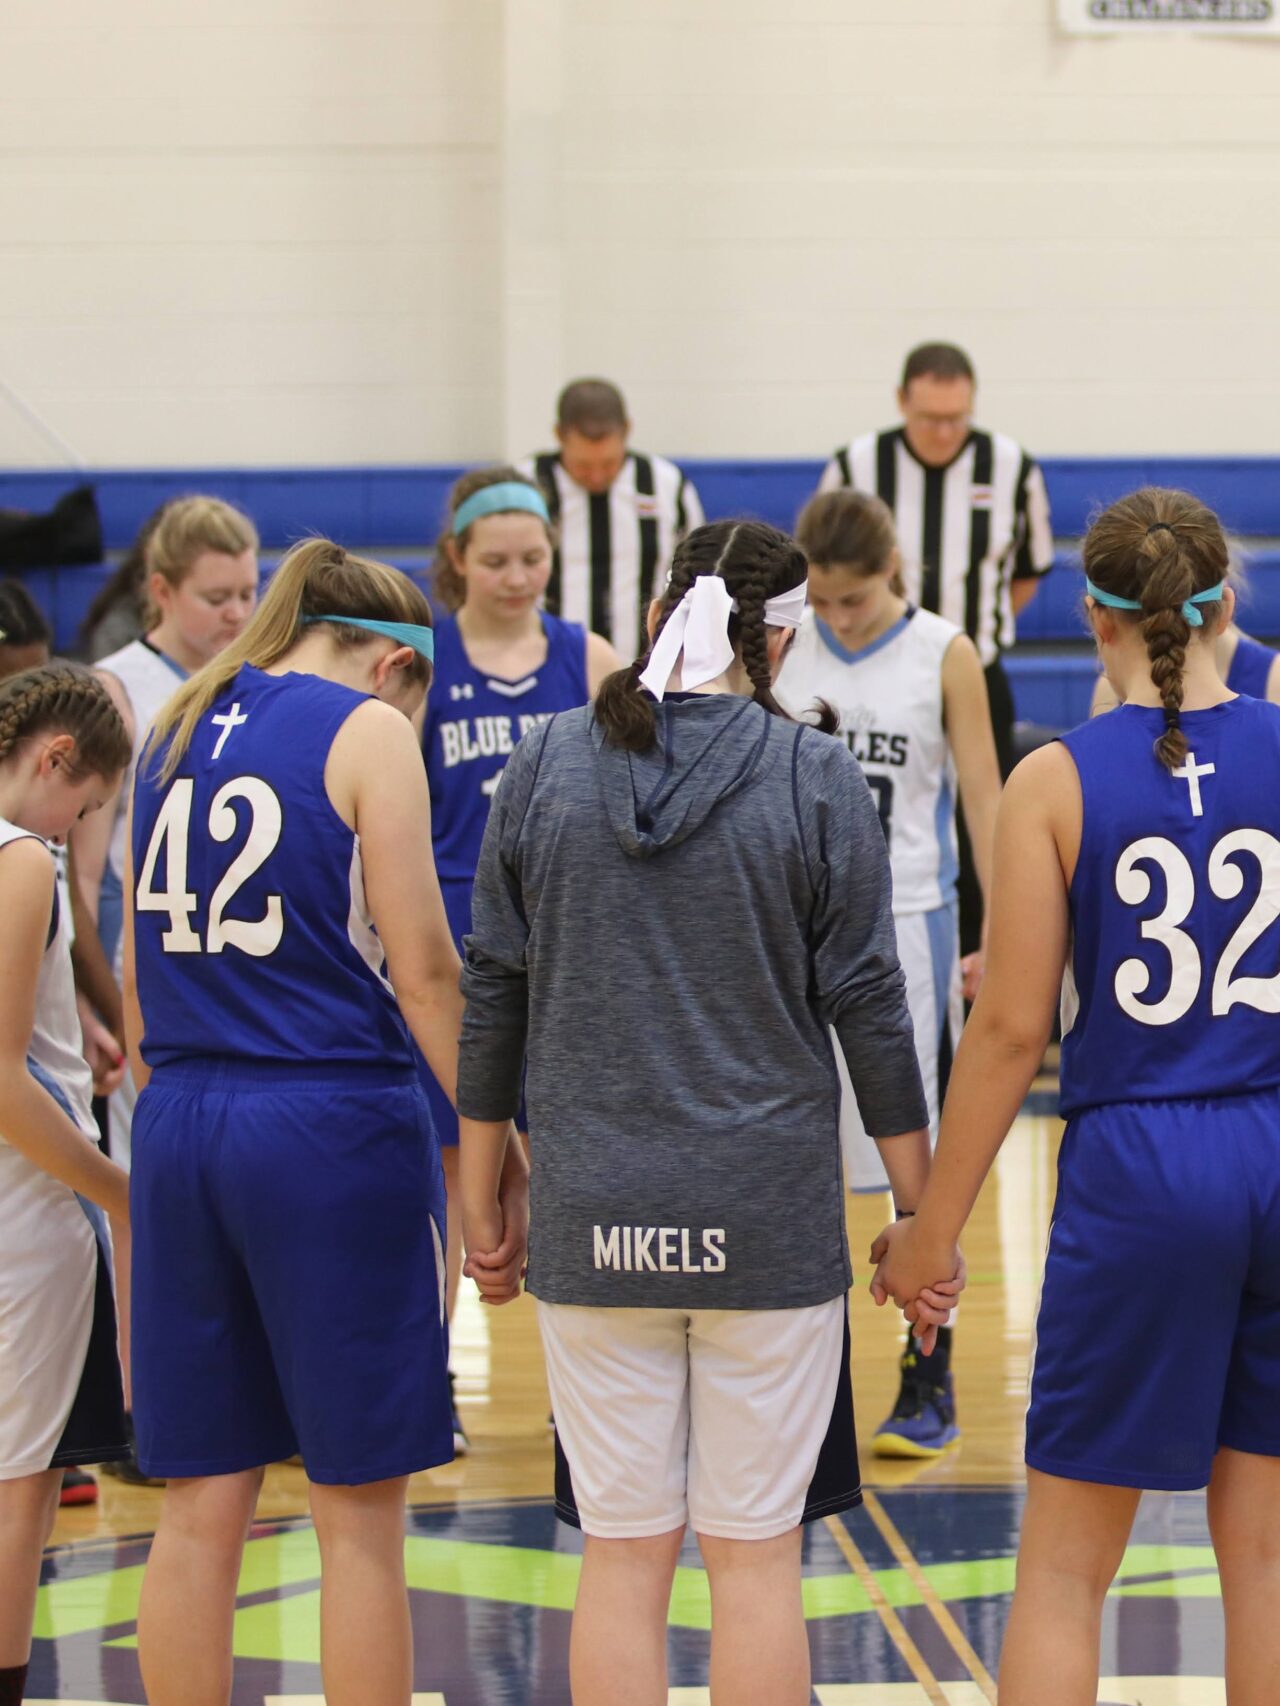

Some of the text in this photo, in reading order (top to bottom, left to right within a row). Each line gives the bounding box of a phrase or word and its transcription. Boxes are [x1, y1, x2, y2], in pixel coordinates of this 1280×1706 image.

[440, 715, 514, 768] BLUE
[836, 730, 908, 767] LES
[136, 775, 284, 957] 42
[593, 1225, 726, 1273] MIKELS
